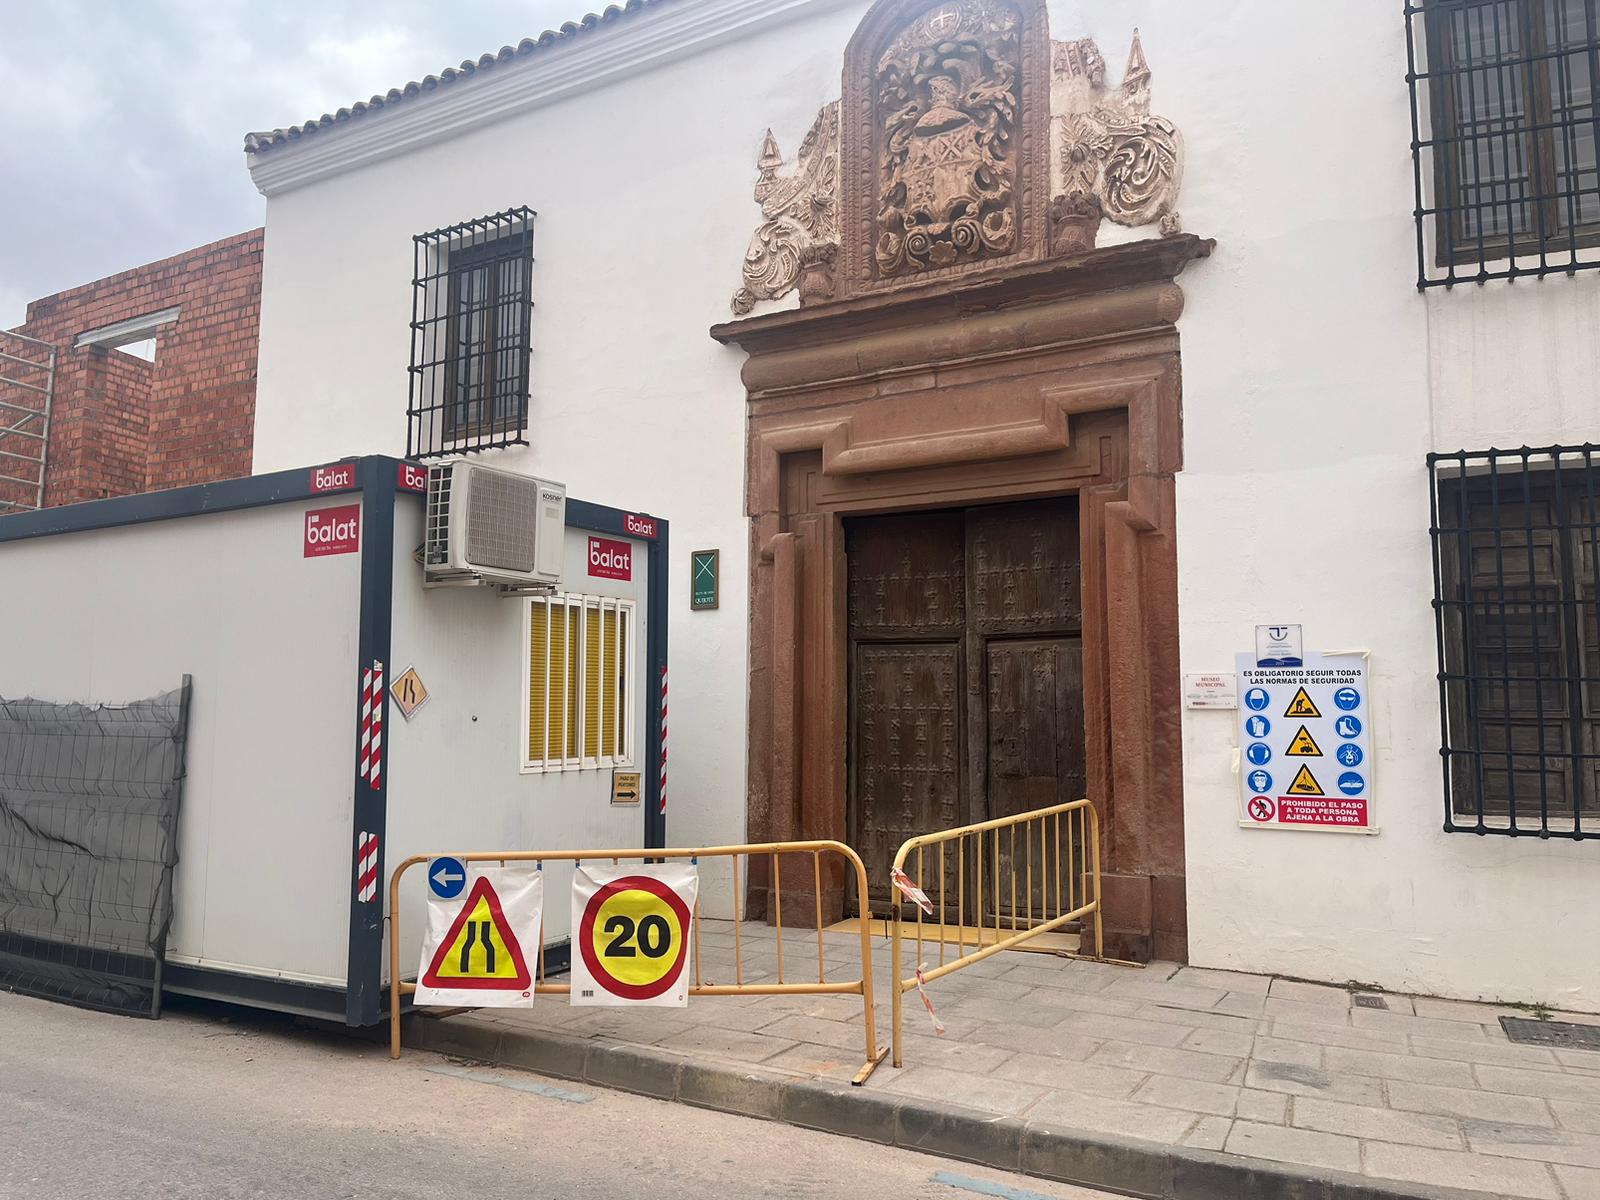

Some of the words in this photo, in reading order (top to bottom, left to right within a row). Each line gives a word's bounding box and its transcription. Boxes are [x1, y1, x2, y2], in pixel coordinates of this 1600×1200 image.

[316, 469, 348, 488] balat
[405, 466, 428, 488] bal
[307, 515, 357, 544] balat
[628, 515, 653, 535] balat
[590, 541, 630, 570] balat
[1318, 808, 1358, 816] PERSONA
[604, 915, 671, 958] 20
